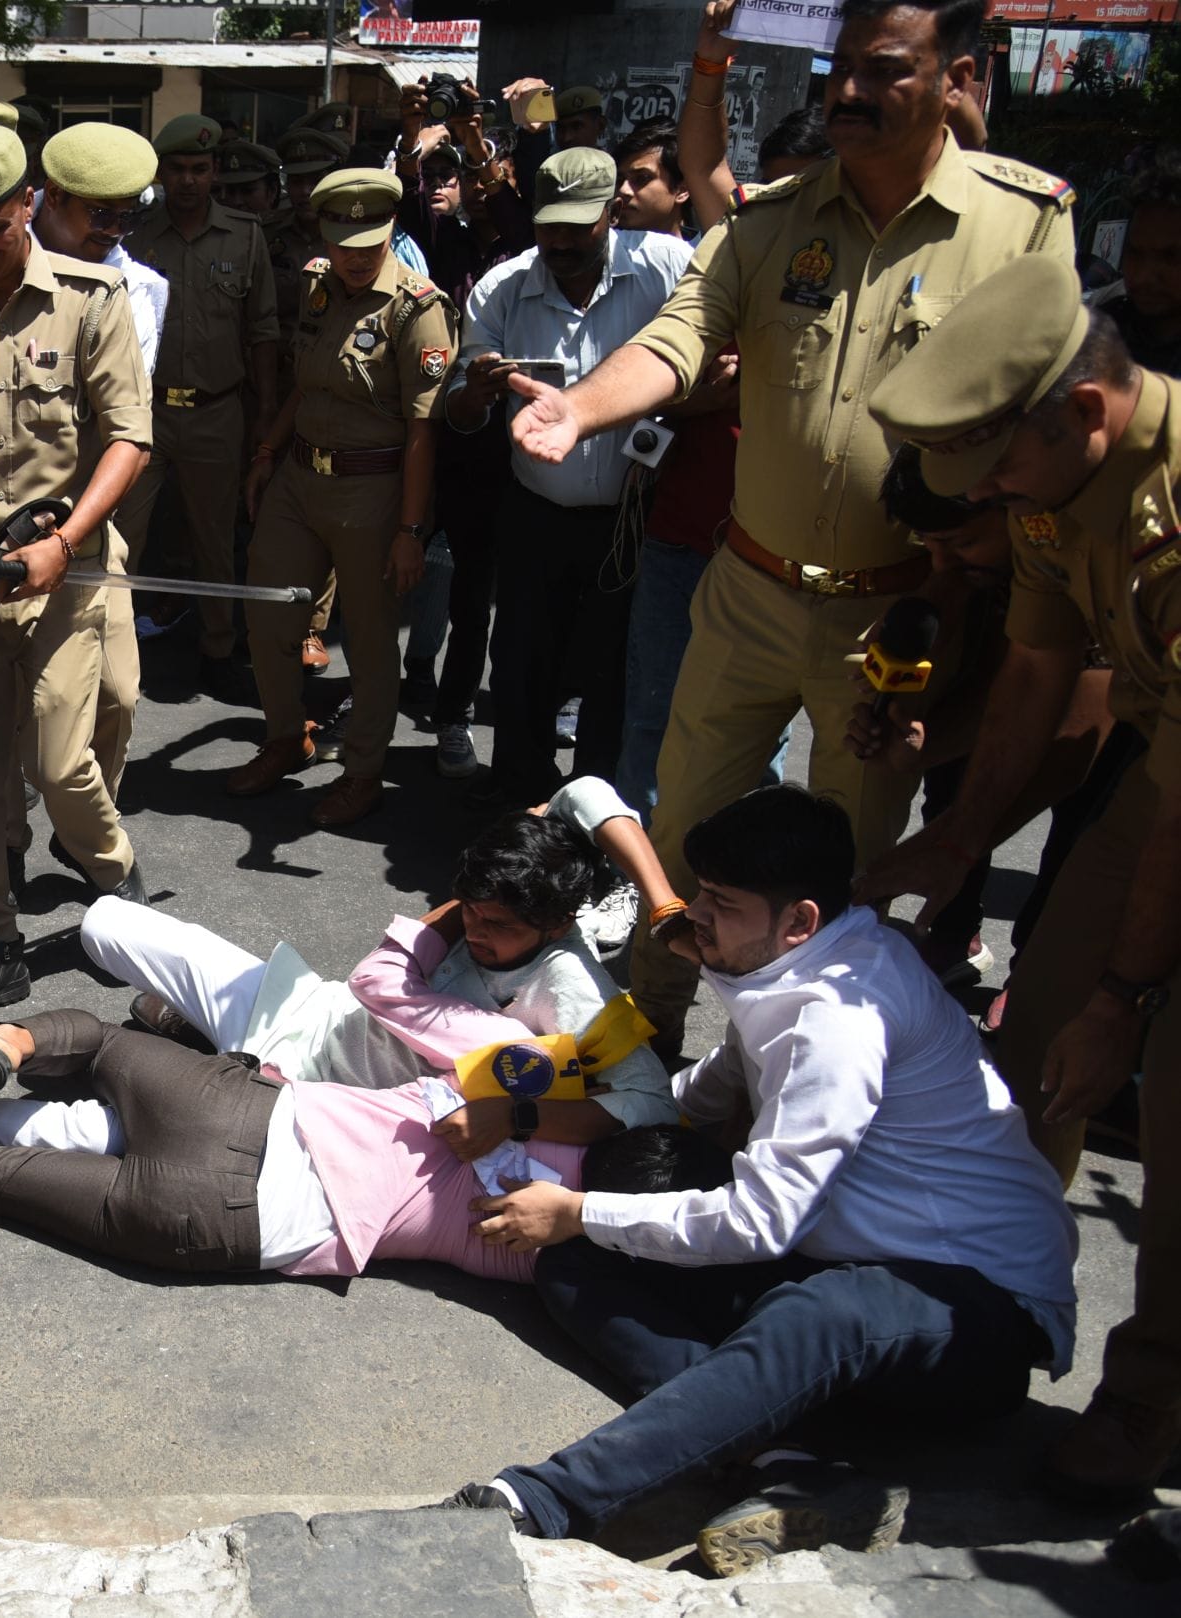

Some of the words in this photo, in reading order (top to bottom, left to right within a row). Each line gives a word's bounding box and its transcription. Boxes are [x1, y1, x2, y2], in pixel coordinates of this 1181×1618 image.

[363, 18, 413, 31] KAMLESH
[418, 21, 478, 32] CHAURASIA
[378, 32, 407, 42] PAAN
[412, 33, 463, 43] BHANDAR
[630, 96, 671, 121] 205
